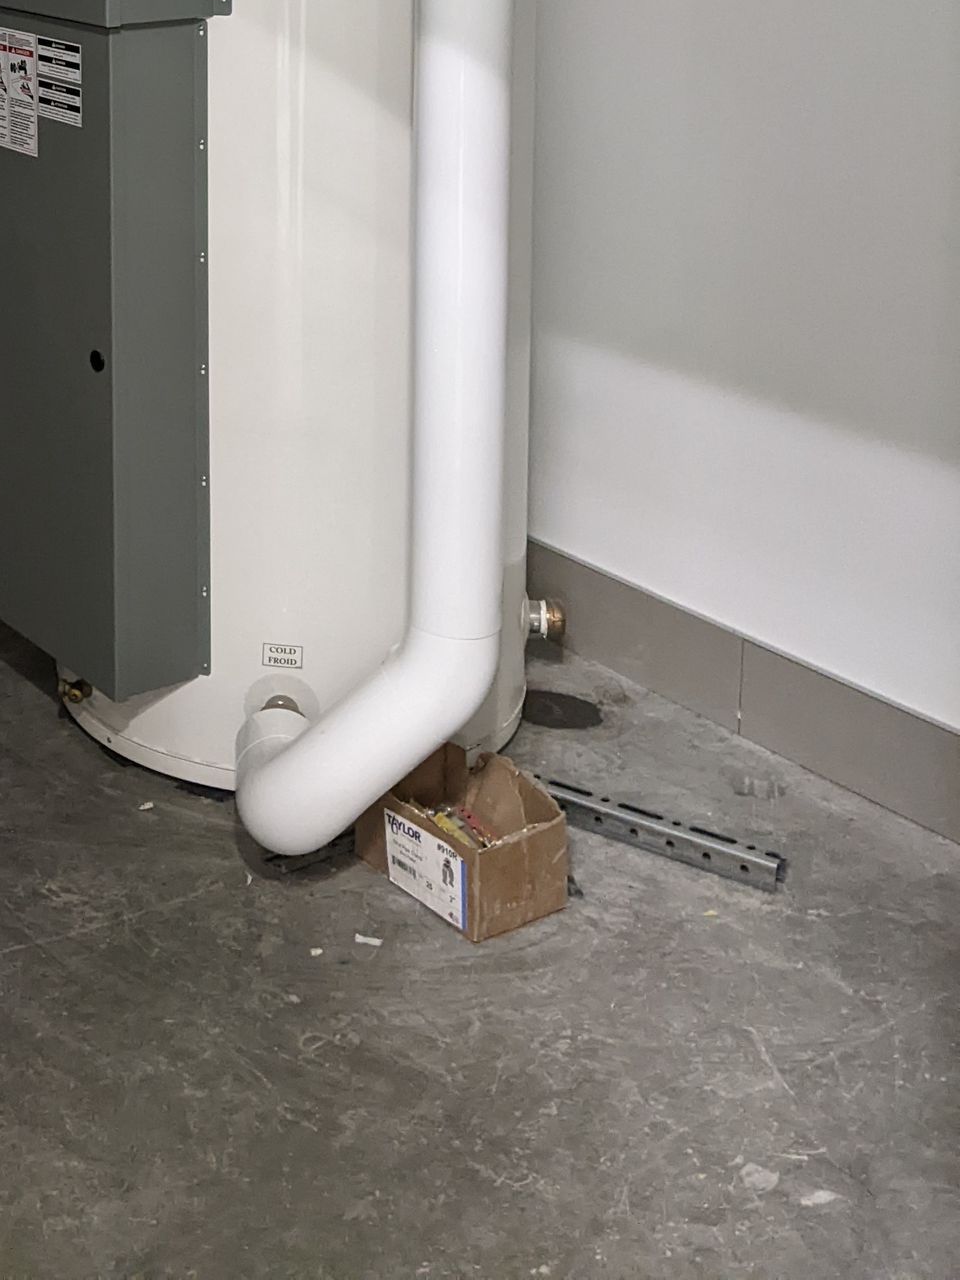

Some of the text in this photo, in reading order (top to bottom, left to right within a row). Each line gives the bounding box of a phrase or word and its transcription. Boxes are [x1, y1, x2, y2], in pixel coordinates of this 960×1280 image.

[269, 646, 297, 655] COLD
[268, 656, 297, 666] FROID
[386, 813, 421, 843] TAYLOR
